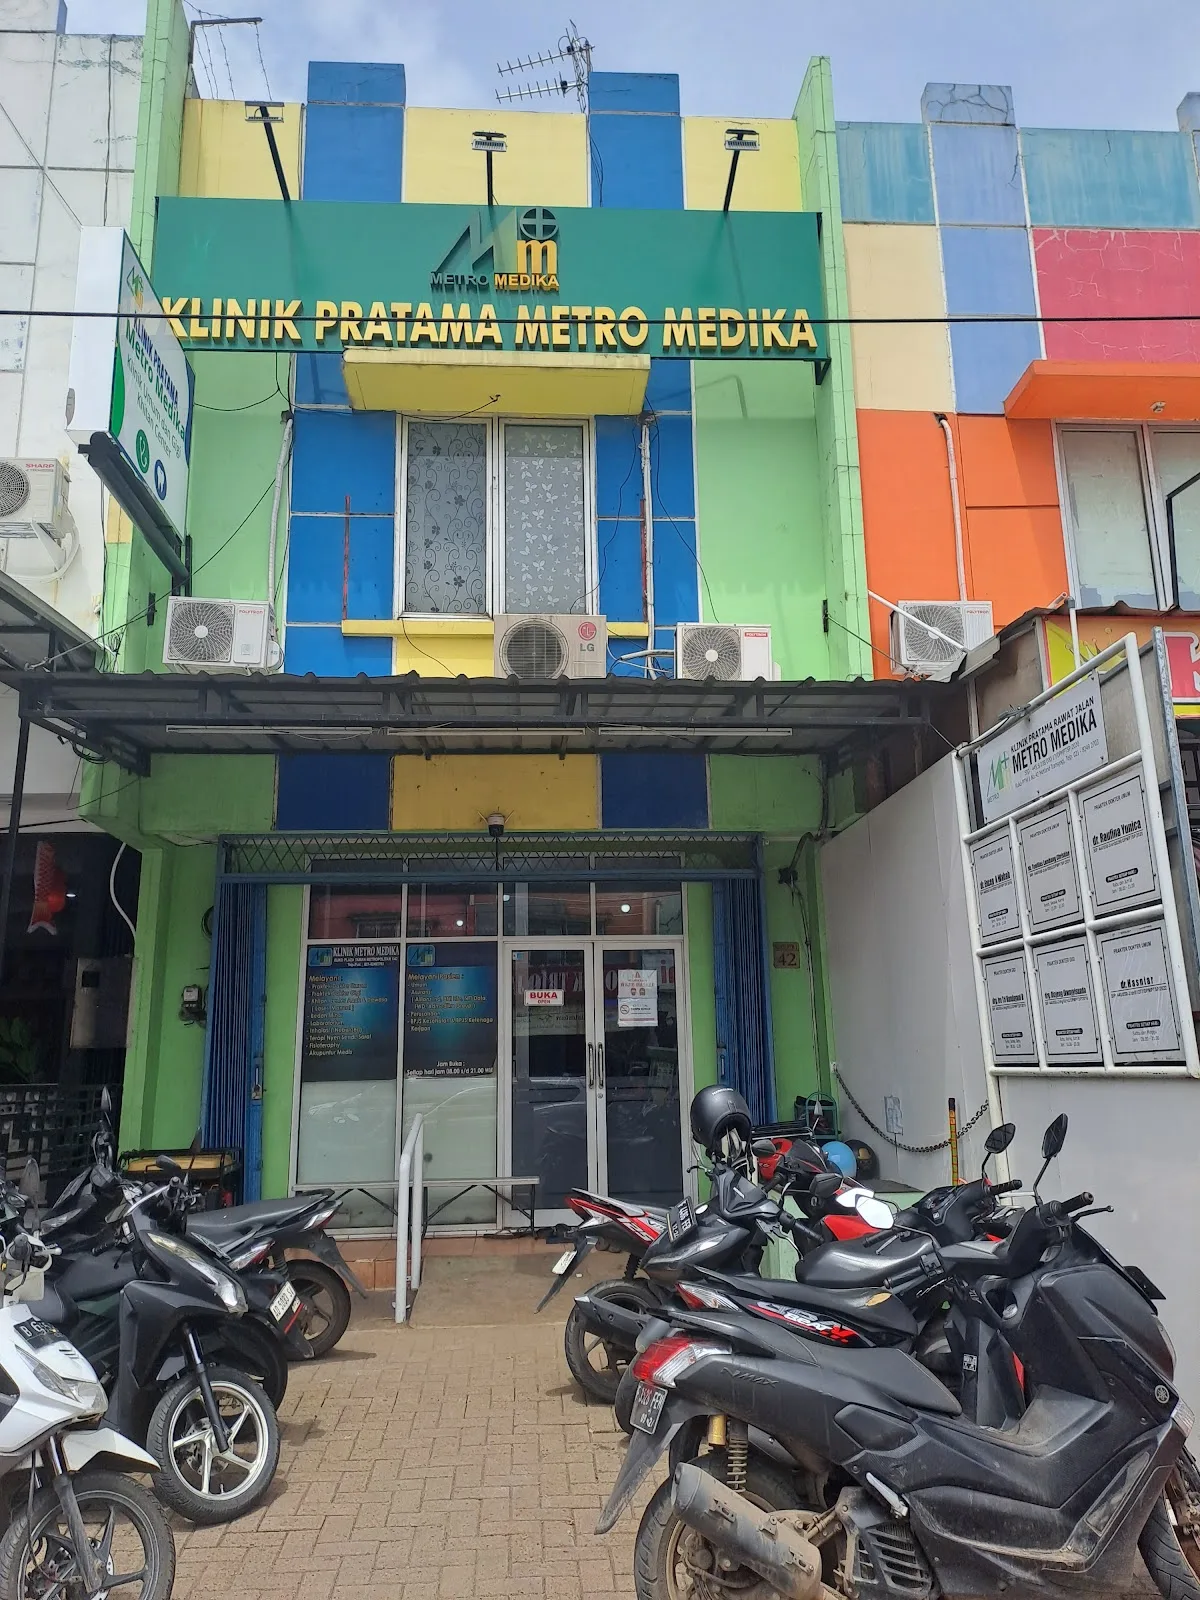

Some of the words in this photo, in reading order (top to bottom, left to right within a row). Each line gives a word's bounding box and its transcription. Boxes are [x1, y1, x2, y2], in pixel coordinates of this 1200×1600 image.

[430, 272, 490, 286] METRO
[494, 273, 560, 290] MEDIKA
[162, 296, 303, 341] KLINIK
[315, 300, 504, 345] PRATAMA
[514, 304, 650, 348] METRO
[662, 306, 819, 349] MEDIKA
[125, 318, 154, 383] Metro
[155, 380, 185, 440] Medika
[134, 311, 154, 362] KLINIK
[153, 350, 178, 410] PRATAMA
[126, 352, 143, 390] Klinik
[143, 381, 160, 422] Umum
[160, 412, 171, 436] dan
[137, 393, 154, 432] Khitan
[154, 425, 172, 459] Center
[580, 643, 594, 652] LG
[1011, 737, 1028, 753] KLINIK
[1028, 721, 1053, 743] PRATAMA
[1053, 709, 1075, 730] RAWAT
[1075, 696, 1095, 715] JALAN
[1012, 737, 1048, 775] METRO
[1050, 708, 1098, 753] MEDIKA
[333, 946, 354, 957] KLINIK
[354, 946, 376, 957] METRO
[376, 945, 400, 956] MEDIKA
[779, 952, 797, 966] 42
[529, 991, 558, 999] BUKA
[20, 1325, 33, 1337] B
